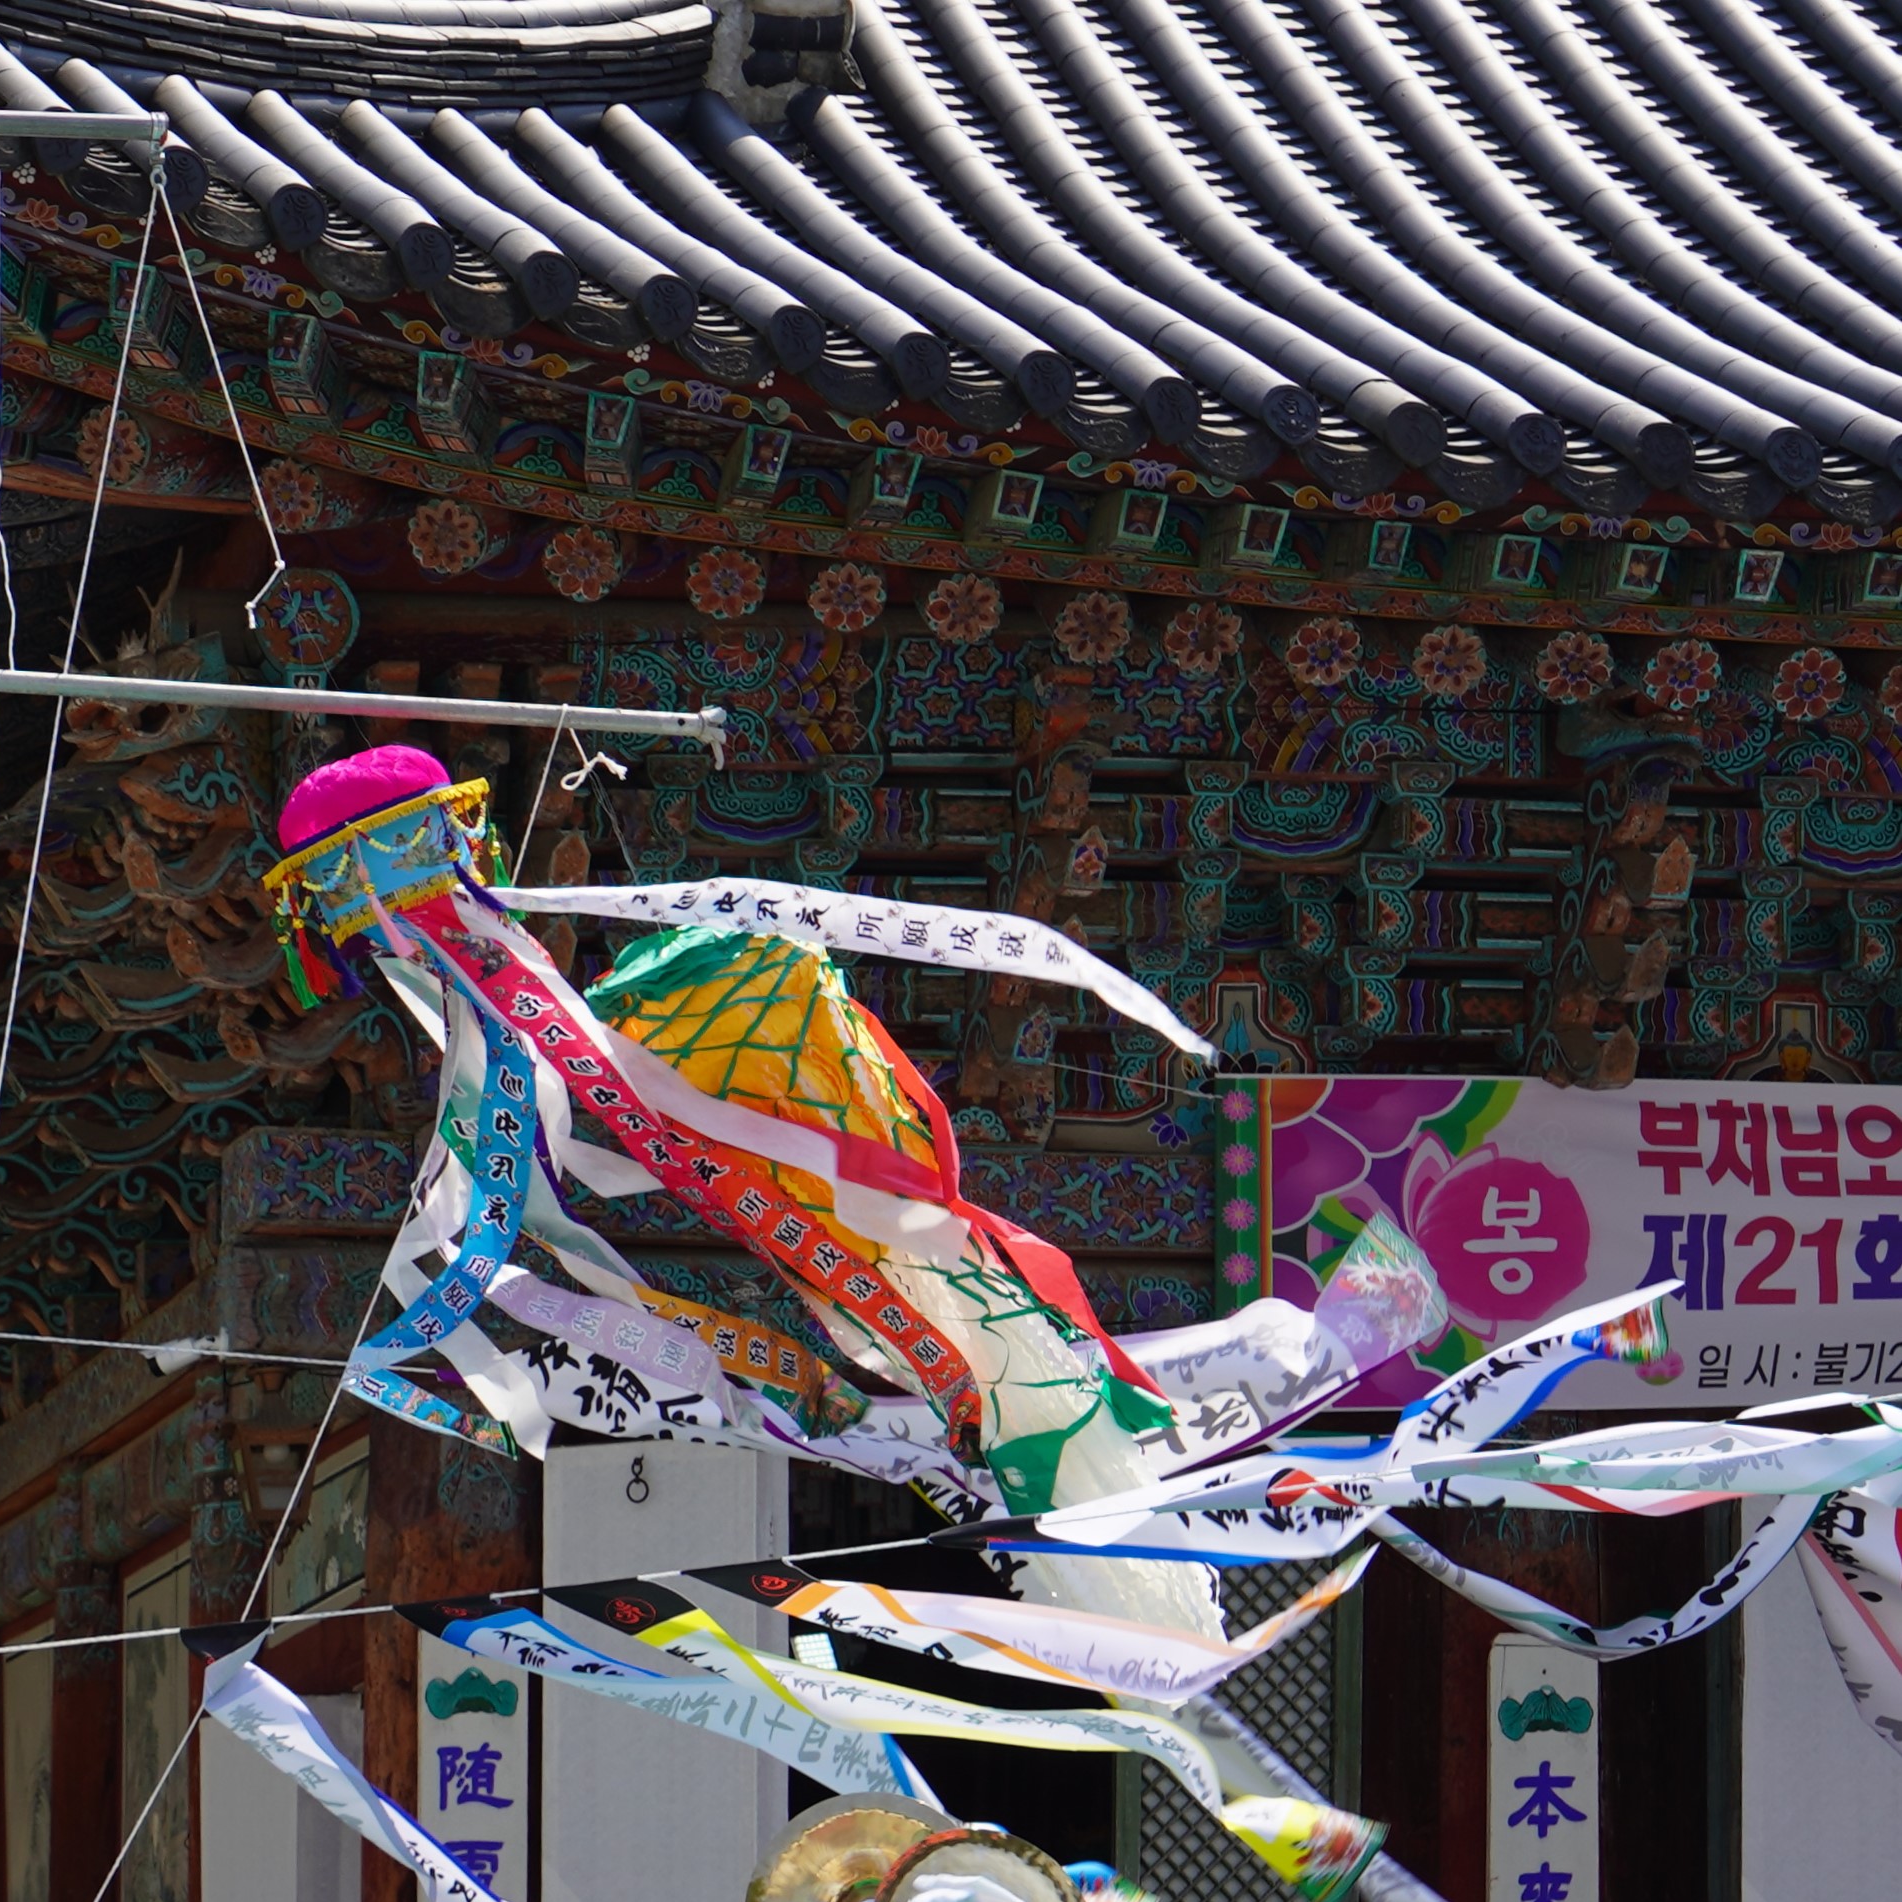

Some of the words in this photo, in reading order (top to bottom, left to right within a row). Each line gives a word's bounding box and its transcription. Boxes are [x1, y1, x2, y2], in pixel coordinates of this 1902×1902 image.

[1462, 1185, 1559, 1295] 봉
[1698, 1345, 1732, 1388] 일
[1744, 1343, 1781, 1387] 시
